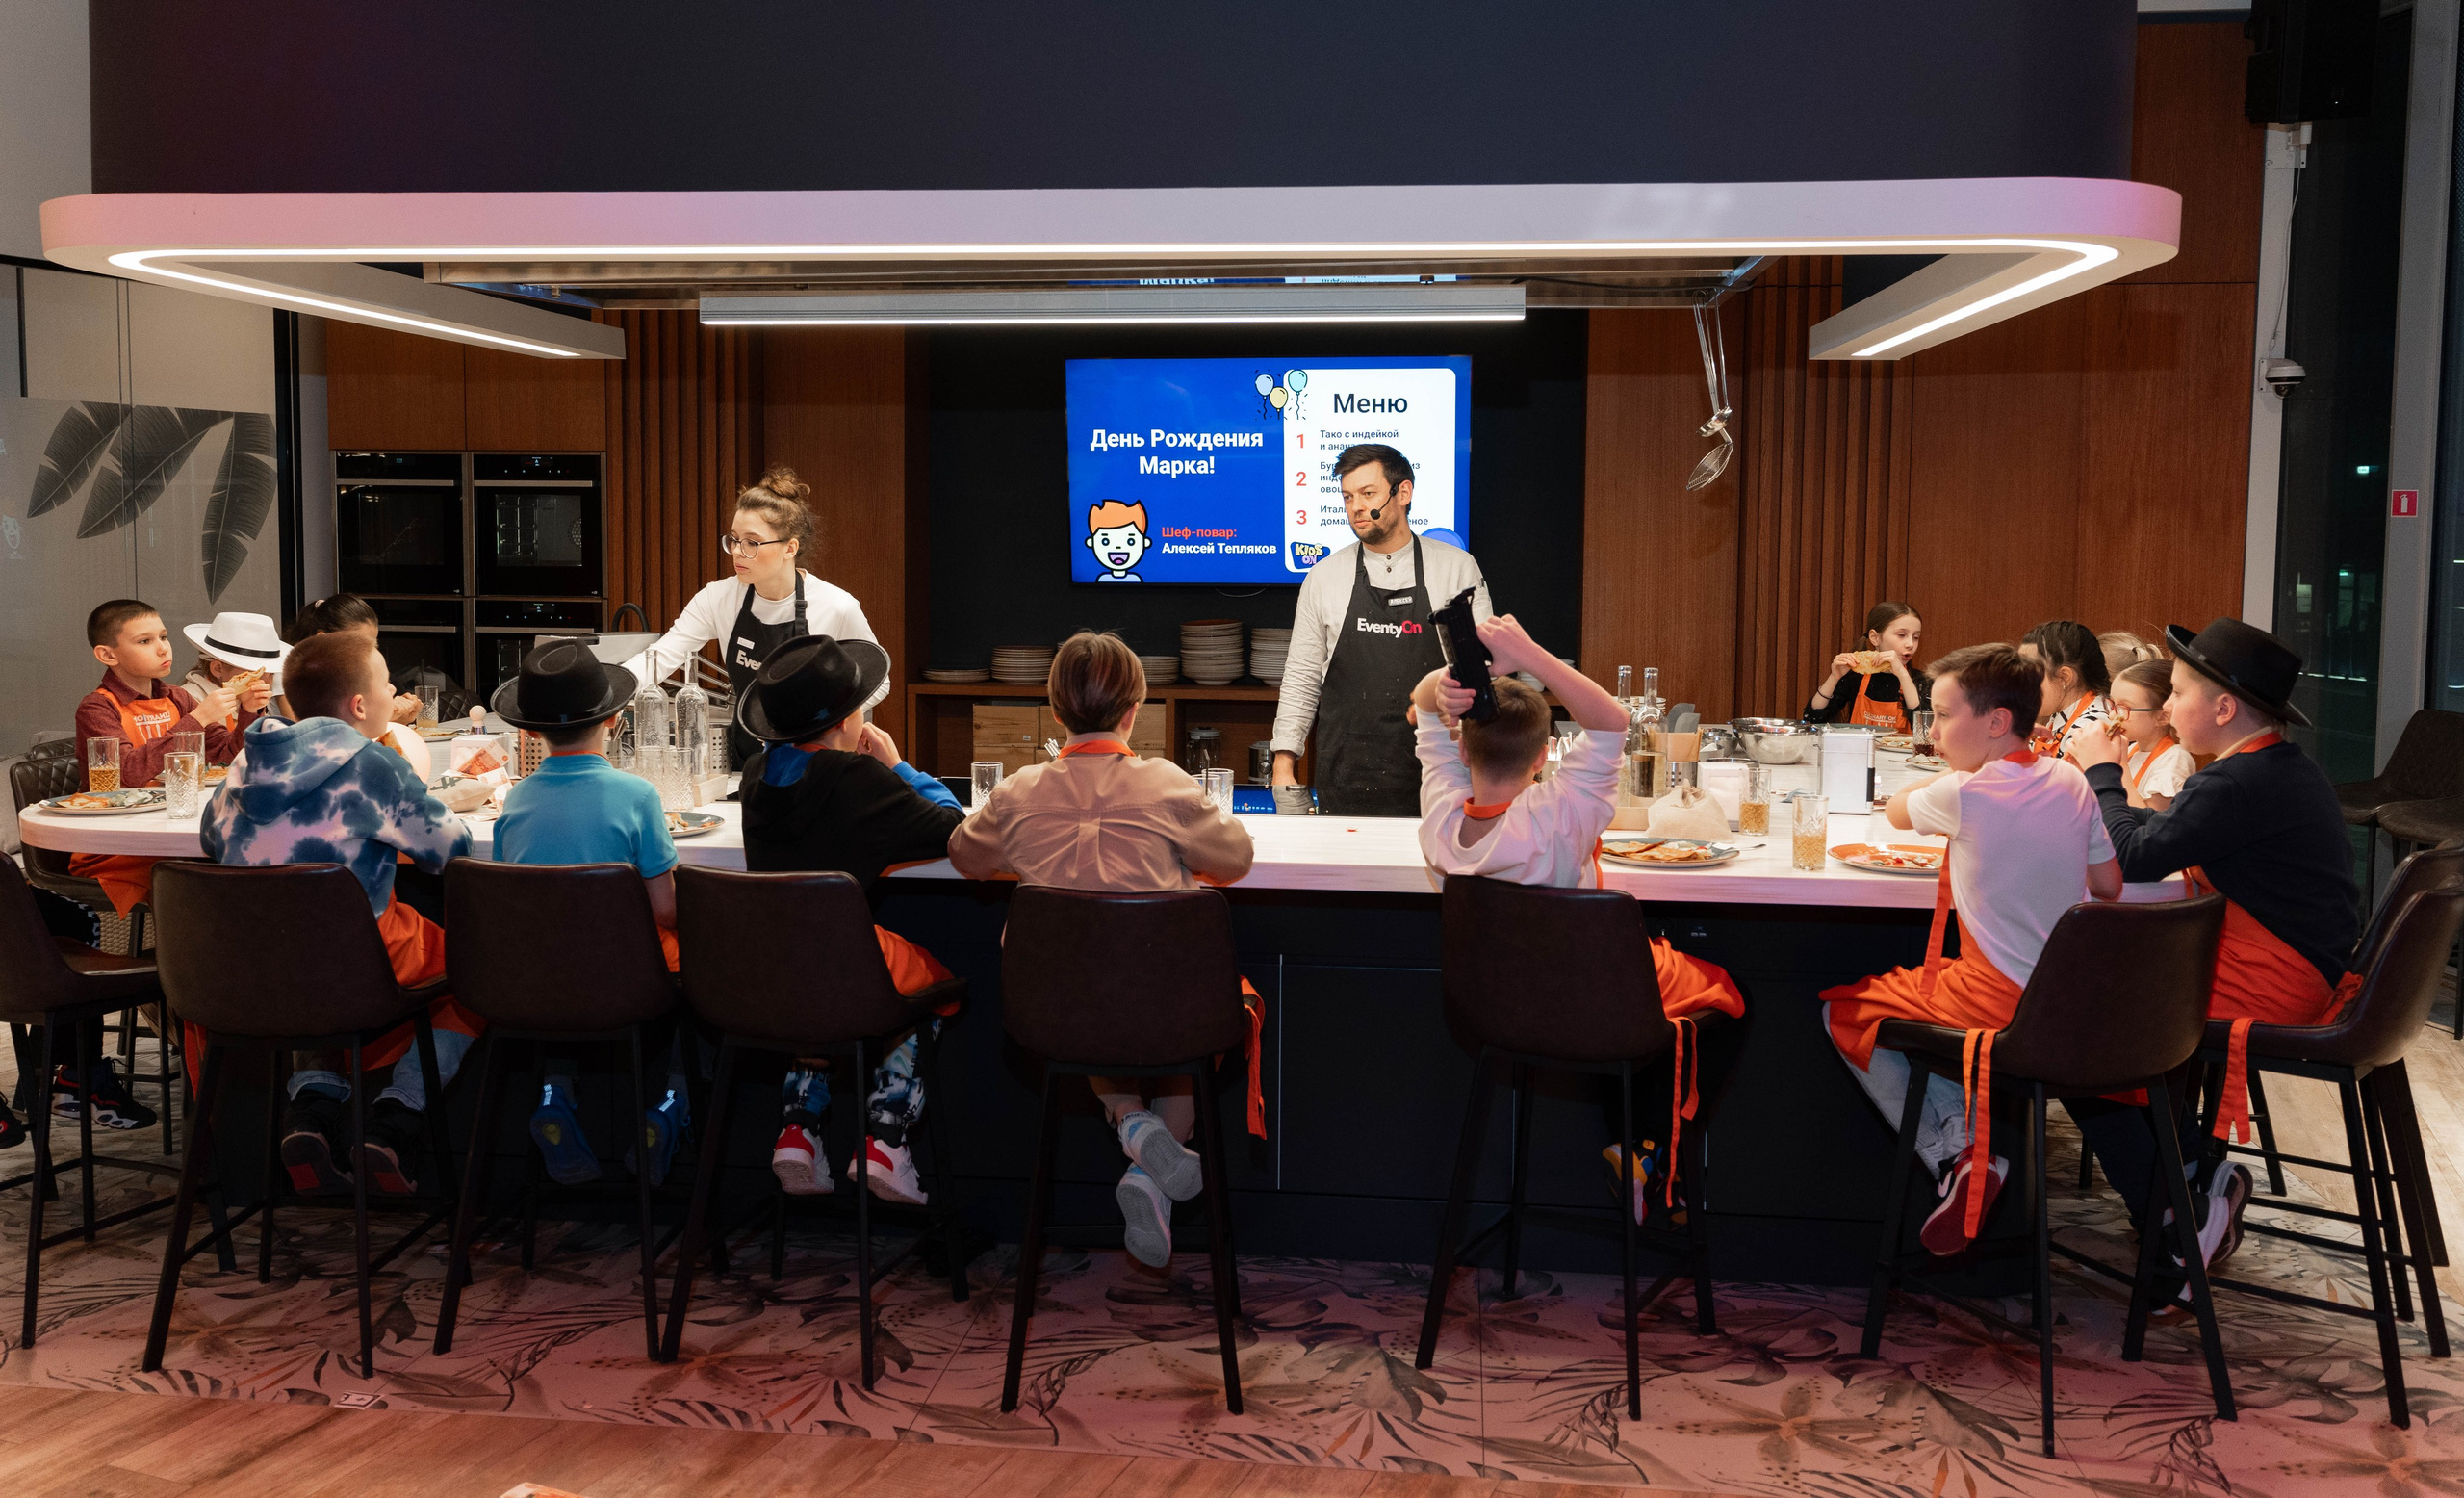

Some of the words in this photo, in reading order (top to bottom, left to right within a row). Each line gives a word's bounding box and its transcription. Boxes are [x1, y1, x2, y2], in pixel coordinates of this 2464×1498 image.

[1333, 393, 1408, 414] Меню
[1090, 429, 1145, 452] День
[1150, 429, 1264, 451] Рождения
[1296, 433, 1305, 449] 1
[1320, 429, 1343, 439] Тако
[1352, 429, 1399, 440] индейкой
[1139, 455, 1216, 478] Марка!
[1296, 471, 1307, 487] 2
[1296, 509, 1307, 525] 3
[1161, 527, 1237, 540] Шеф-повар:
[1161, 542, 1215, 554] Алексей
[1217, 543, 1277, 555] Тепляков
[1295, 542, 1324, 557] KIDS
[1301, 554, 1318, 566] ON
[1357, 617, 1423, 638] EventyOn
